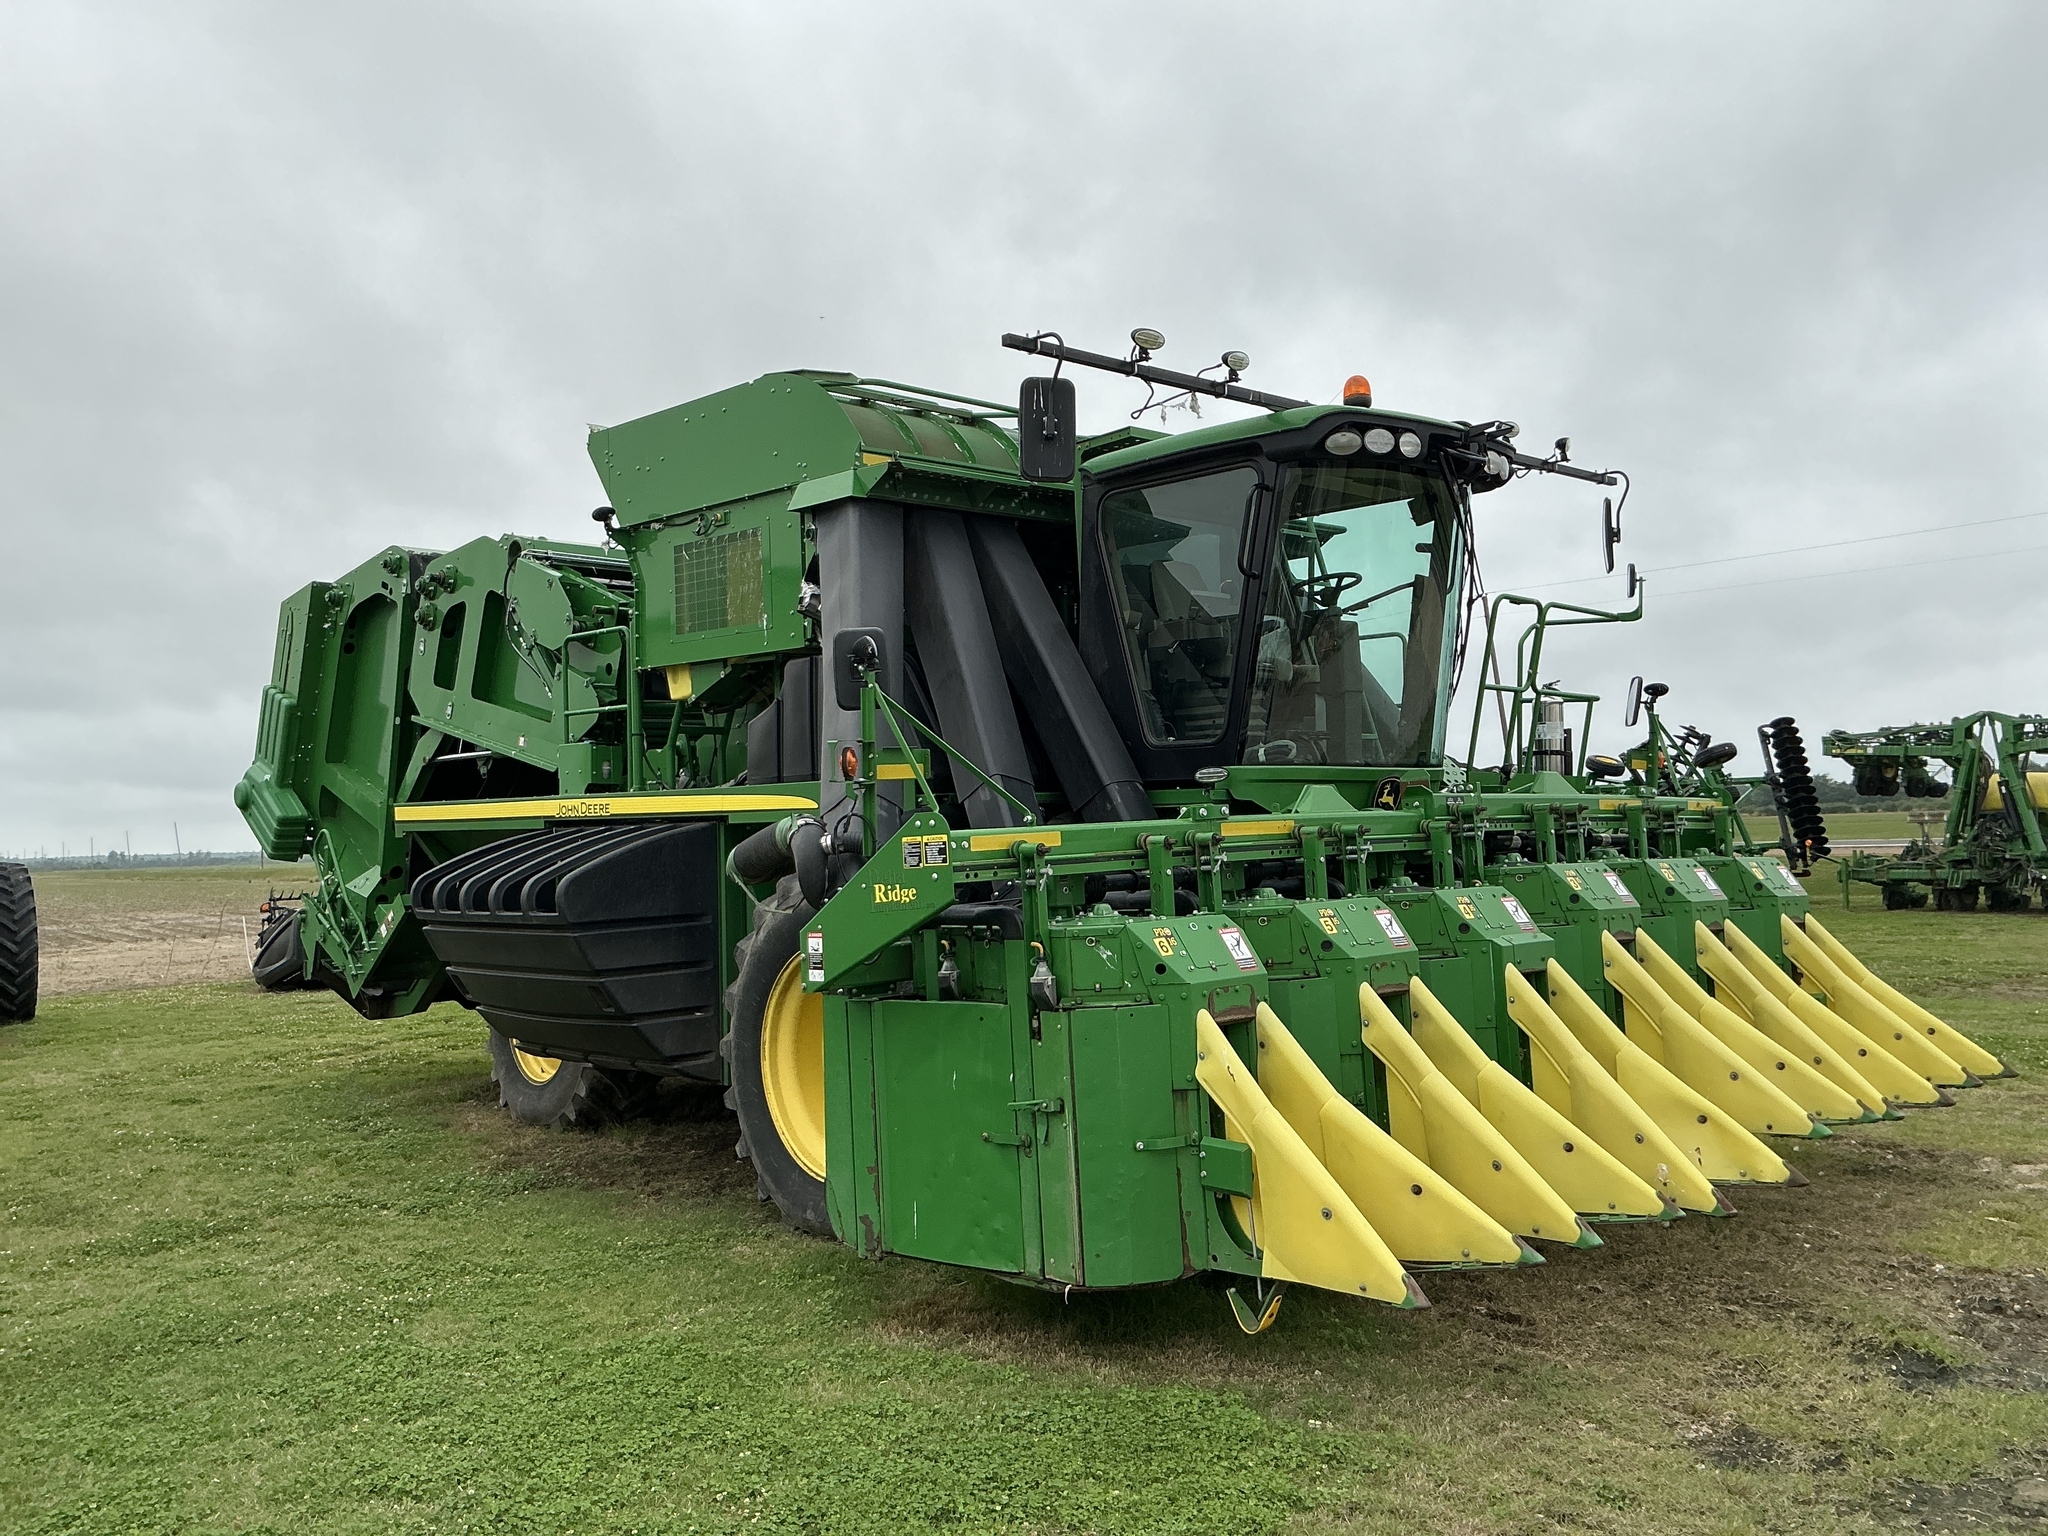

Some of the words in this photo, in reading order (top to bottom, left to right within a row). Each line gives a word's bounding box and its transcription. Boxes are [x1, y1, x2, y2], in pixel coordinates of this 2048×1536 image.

[556, 803, 579, 816] JOHN
[580, 801, 611, 815] DEERE
[873, 883, 917, 904] Ridge
